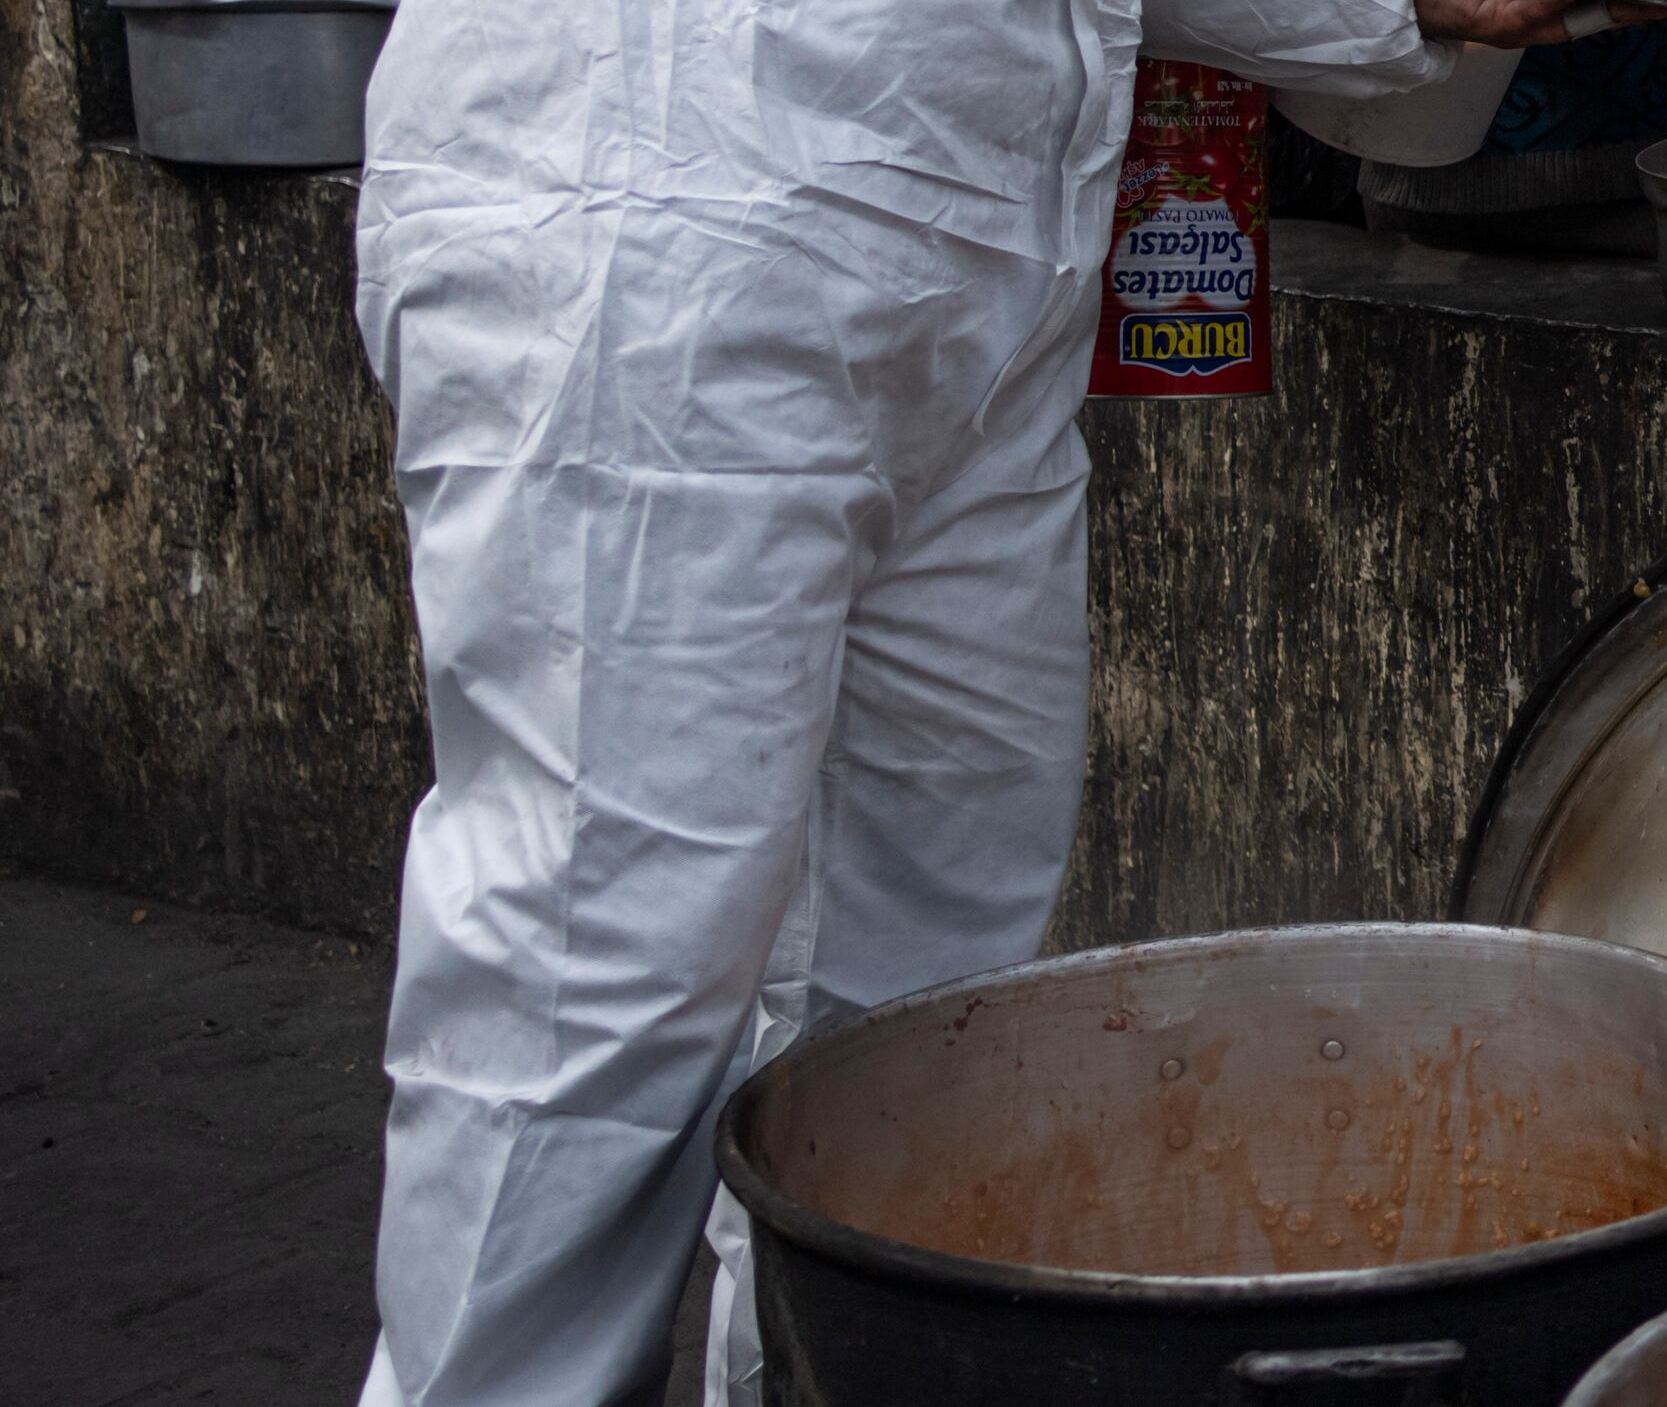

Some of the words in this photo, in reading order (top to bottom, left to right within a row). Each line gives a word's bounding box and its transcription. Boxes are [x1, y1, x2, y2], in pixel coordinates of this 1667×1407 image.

[1137, 114, 1240, 128] TOMATENMARK
[1123, 163, 1164, 192] Lezzet
[1186, 209, 1239, 223] TOMATO
[1129, 224, 1244, 265] Salçası
[1113, 269, 1254, 302] Domates
[1130, 320, 1246, 360] BURCU
